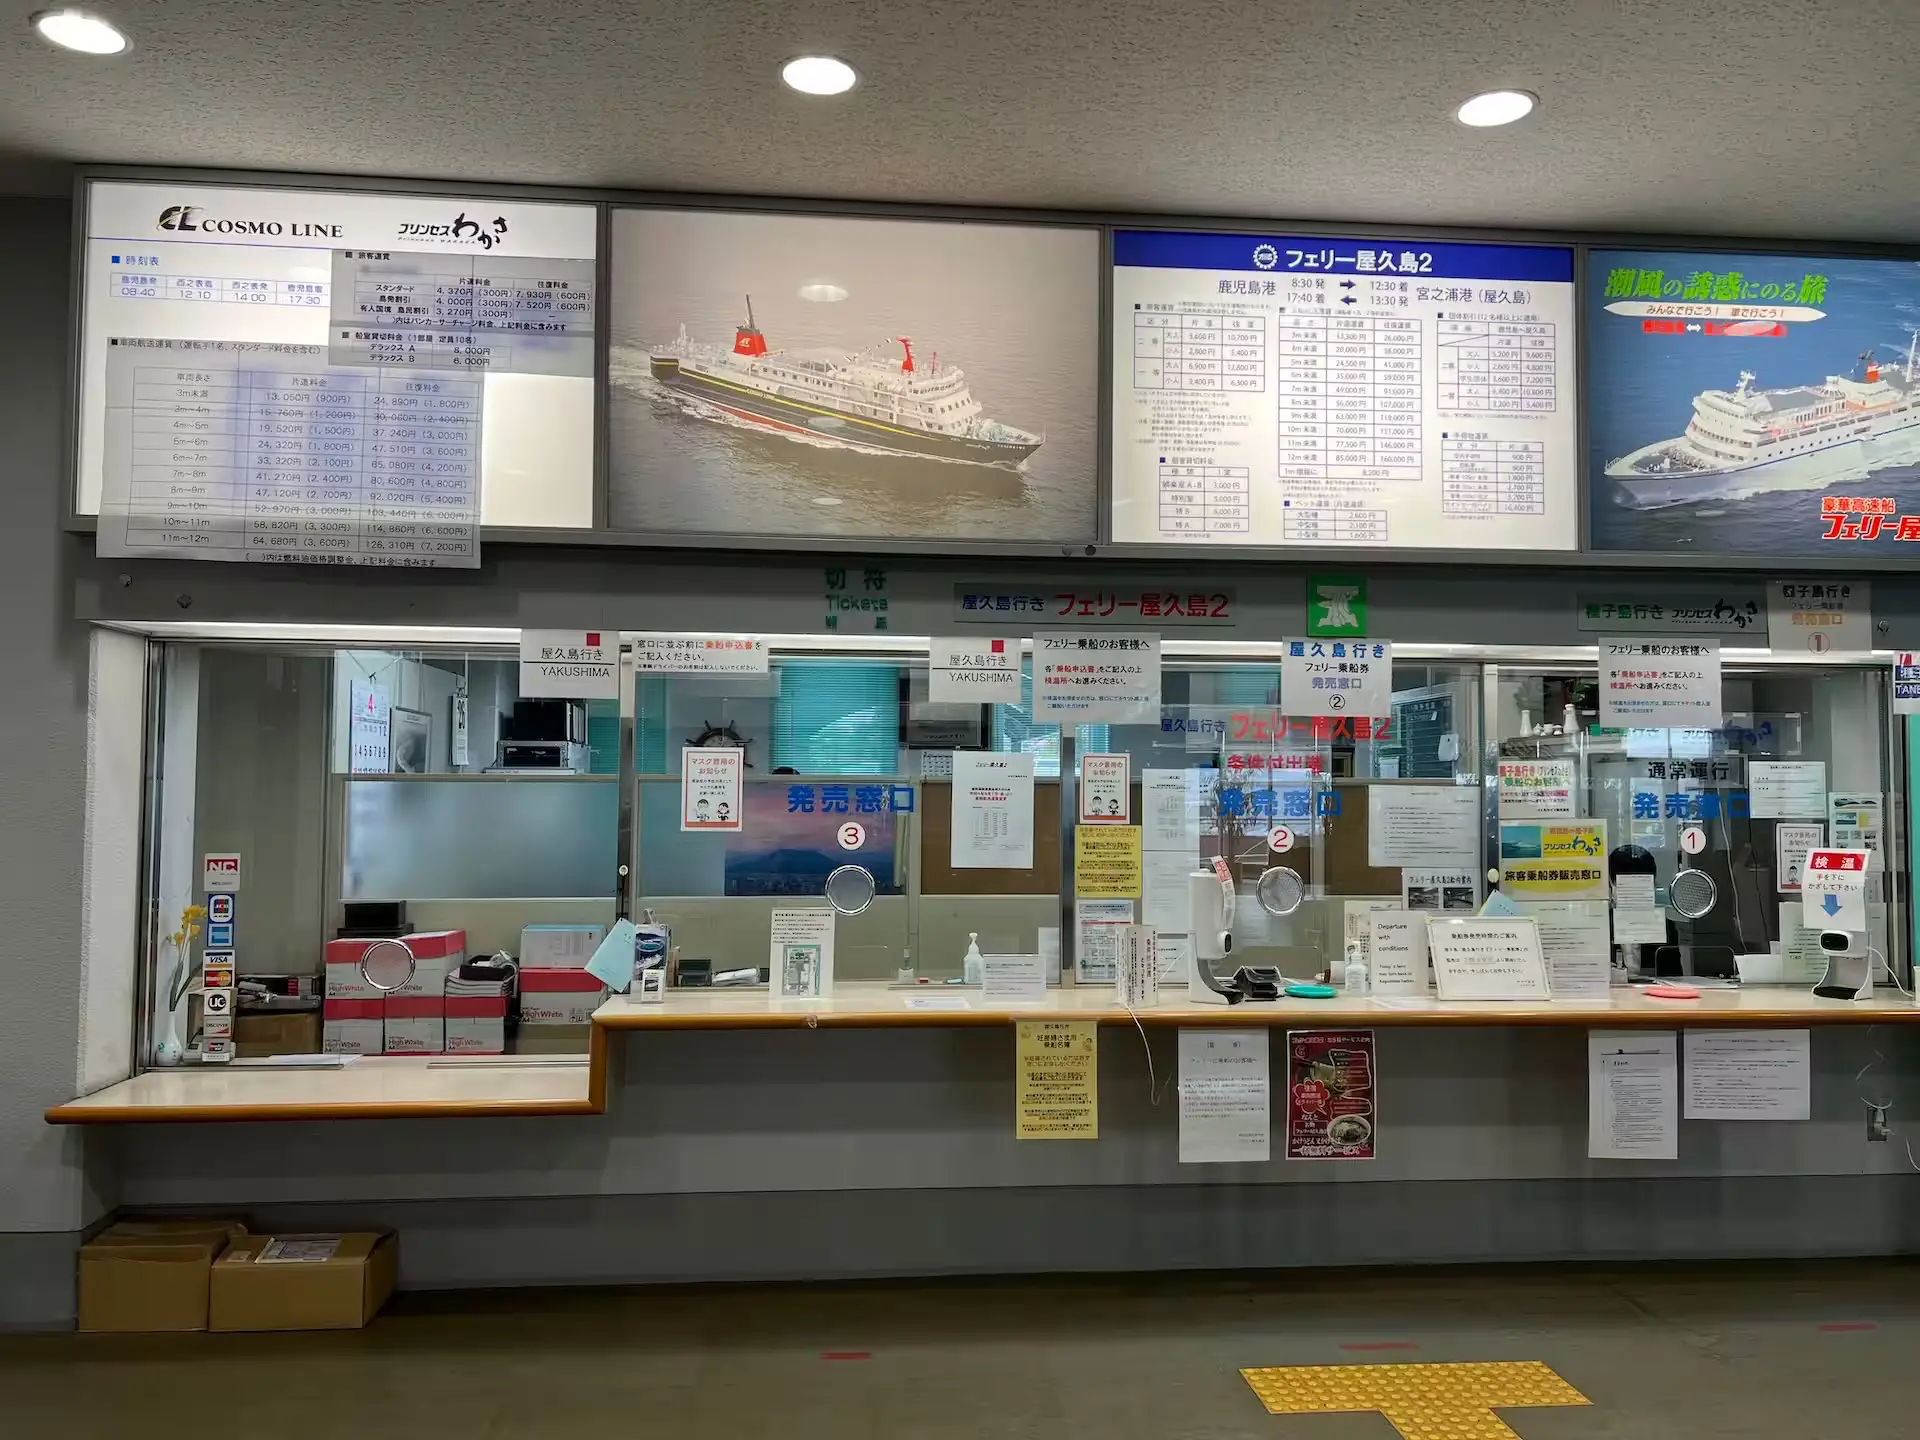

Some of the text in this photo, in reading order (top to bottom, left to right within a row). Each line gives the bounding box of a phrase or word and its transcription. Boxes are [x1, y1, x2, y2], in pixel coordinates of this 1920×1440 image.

[202, 219, 344, 238] COSMO LINE
[125, 255, 160, 267] 時刻表
[358, 251, 391, 261] 旅客運賃
[1286, 249, 1433, 273] フェリー屋久島2
[375, 284, 415, 293] スタンダード
[459, 277, 569, 289] 片道料金 往復料金
[1218, 279, 1277, 295] 鹿児島港
[1292, 278, 1313, 288] 8:30
[1316, 278, 1325, 289] 発
[1370, 281, 1396, 291] 12:30
[1604, 268, 1828, 304] 潮風の誘惑にのる旅
[121, 287, 156, 297] 08:40
[1287, 292, 1313, 303] 17:40
[1370, 295, 1396, 306] 13:30
[1398, 296, 1408, 306] 発
[369, 344, 404, 352] デラックス
[408, 344, 415, 352] A
[369, 354, 404, 363] デラックス
[408, 355, 415, 363] B
[177, 373, 441, 393] 車両長さ 片道料金 往復料金
[1822, 497, 1896, 514] 豪華高速船
[962, 593, 1229, 618] 屋久島行き フェリー屋久島2
[1585, 604, 1664, 620] 種子島行き
[1044, 638, 1150, 649] フェリー乗船のお客様へ
[1289, 641, 1385, 659] 屋久島行き
[1608, 644, 1710, 656] フェリー乗船のお客様へ
[541, 647, 603, 661] 屋久島行き
[638, 652, 705, 661] ご記入ください。
[949, 655, 1007, 666] 屋久島行き
[540, 665, 610, 678] YAKUSHIMA
[1305, 662, 1369, 674] フェリー乗船券
[949, 671, 1013, 682] YAKUSHIMA
[1312, 677, 1361, 689] 発売窓口
[1161, 718, 1228, 733] 屋久島行き
[1648, 762, 1729, 780] 通常運行
[788, 784, 914, 813] 発売窓口
[1220, 788, 1342, 817] 発売窓口
[844, 827, 859, 845] 3
[1273, 830, 1288, 848] 2
[1505, 870, 1601, 881] 旅客乗船券販売窓口
[1808, 883, 1857, 891] かざして下さい
